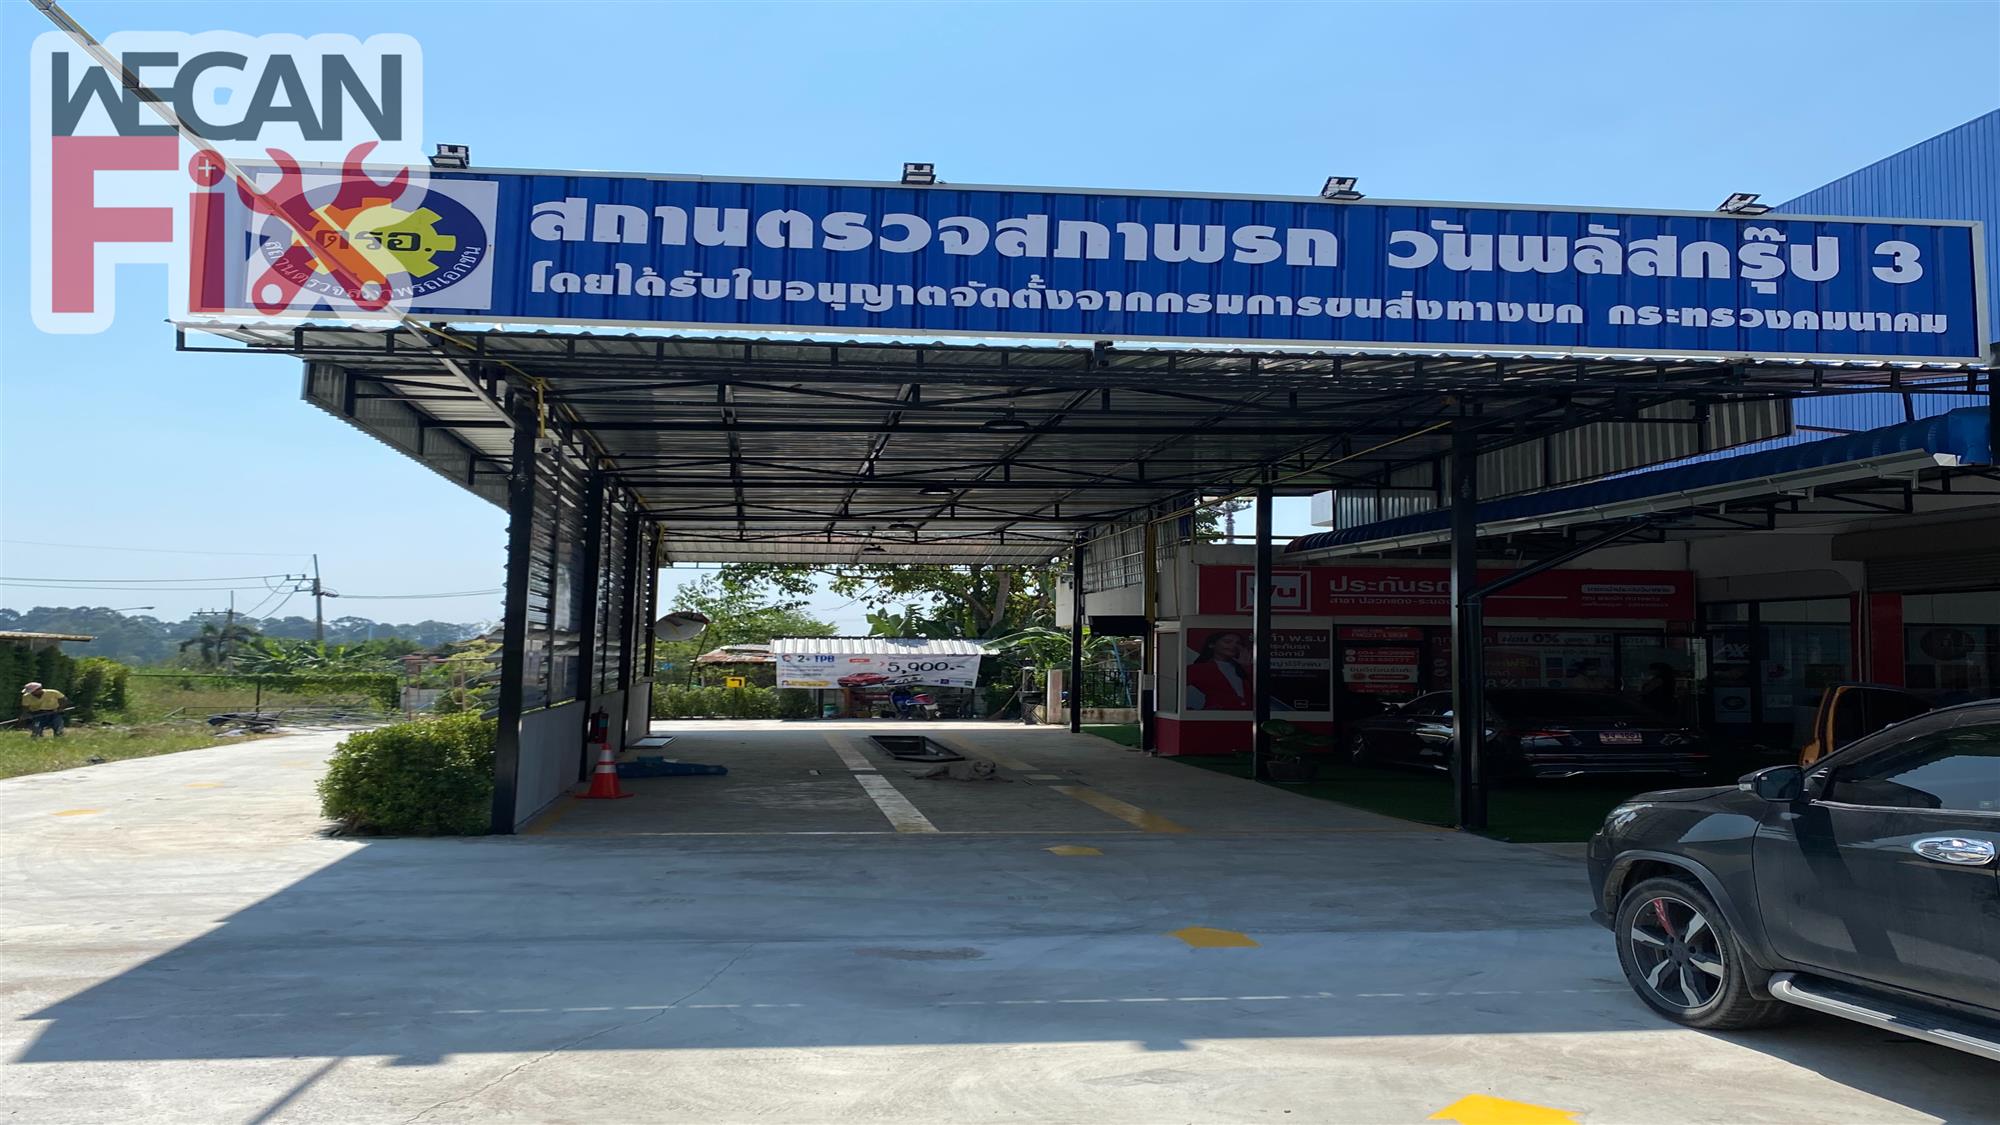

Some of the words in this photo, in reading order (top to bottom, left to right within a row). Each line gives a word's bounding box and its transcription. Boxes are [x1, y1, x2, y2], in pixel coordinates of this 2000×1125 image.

[531, 198, 1337, 266] สถานตรวจสภาพรถ
[1389, 220, 1839, 293] วันพลัสกรุ๊ป
[1873, 241, 1922, 283] 3
[532, 261, 1583, 325] โดยได้รับใบอนุญาตจัดตั้งจากกรมการขนส่งทางบก
[1610, 305, 1948, 334] กระทรวงคมนาคม
